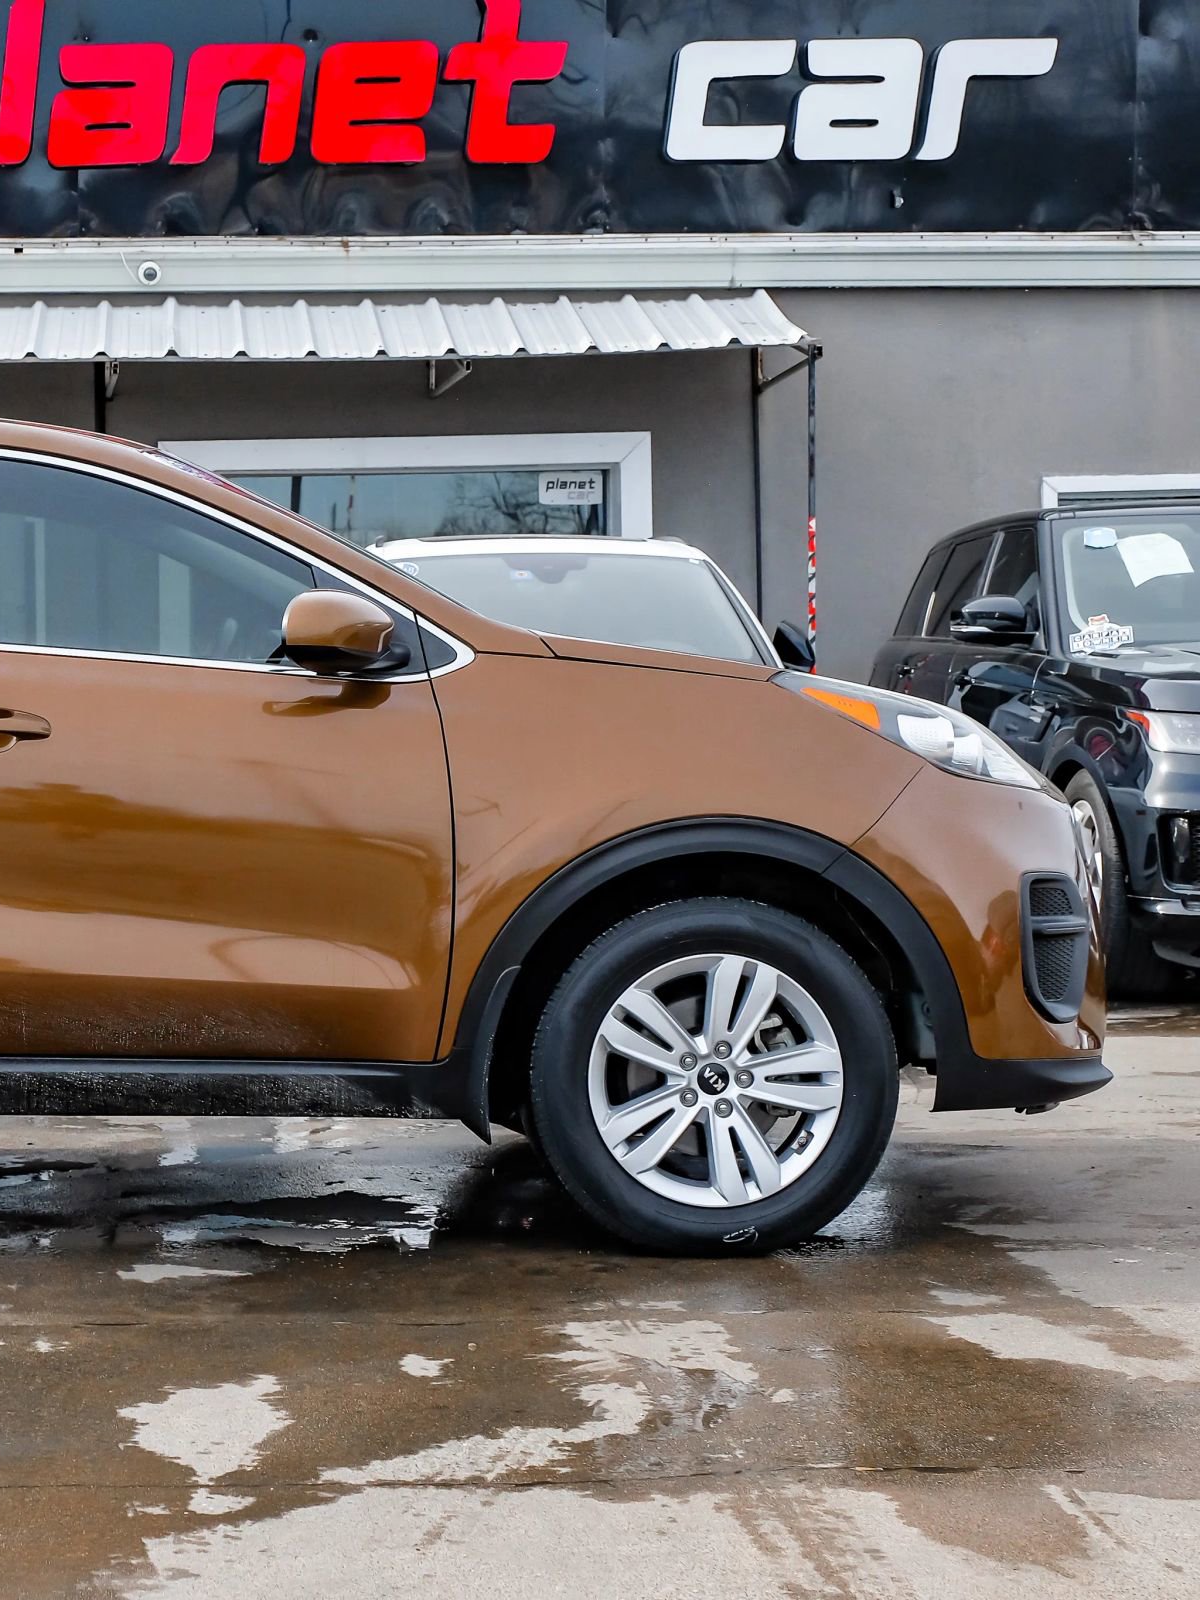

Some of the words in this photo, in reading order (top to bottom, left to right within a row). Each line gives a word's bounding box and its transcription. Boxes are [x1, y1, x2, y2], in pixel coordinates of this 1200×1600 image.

[666, 38, 1059, 162] car
[545, 477, 596, 493] planet
[567, 491, 595, 500] car
[703, 1066, 726, 1092] KIA
